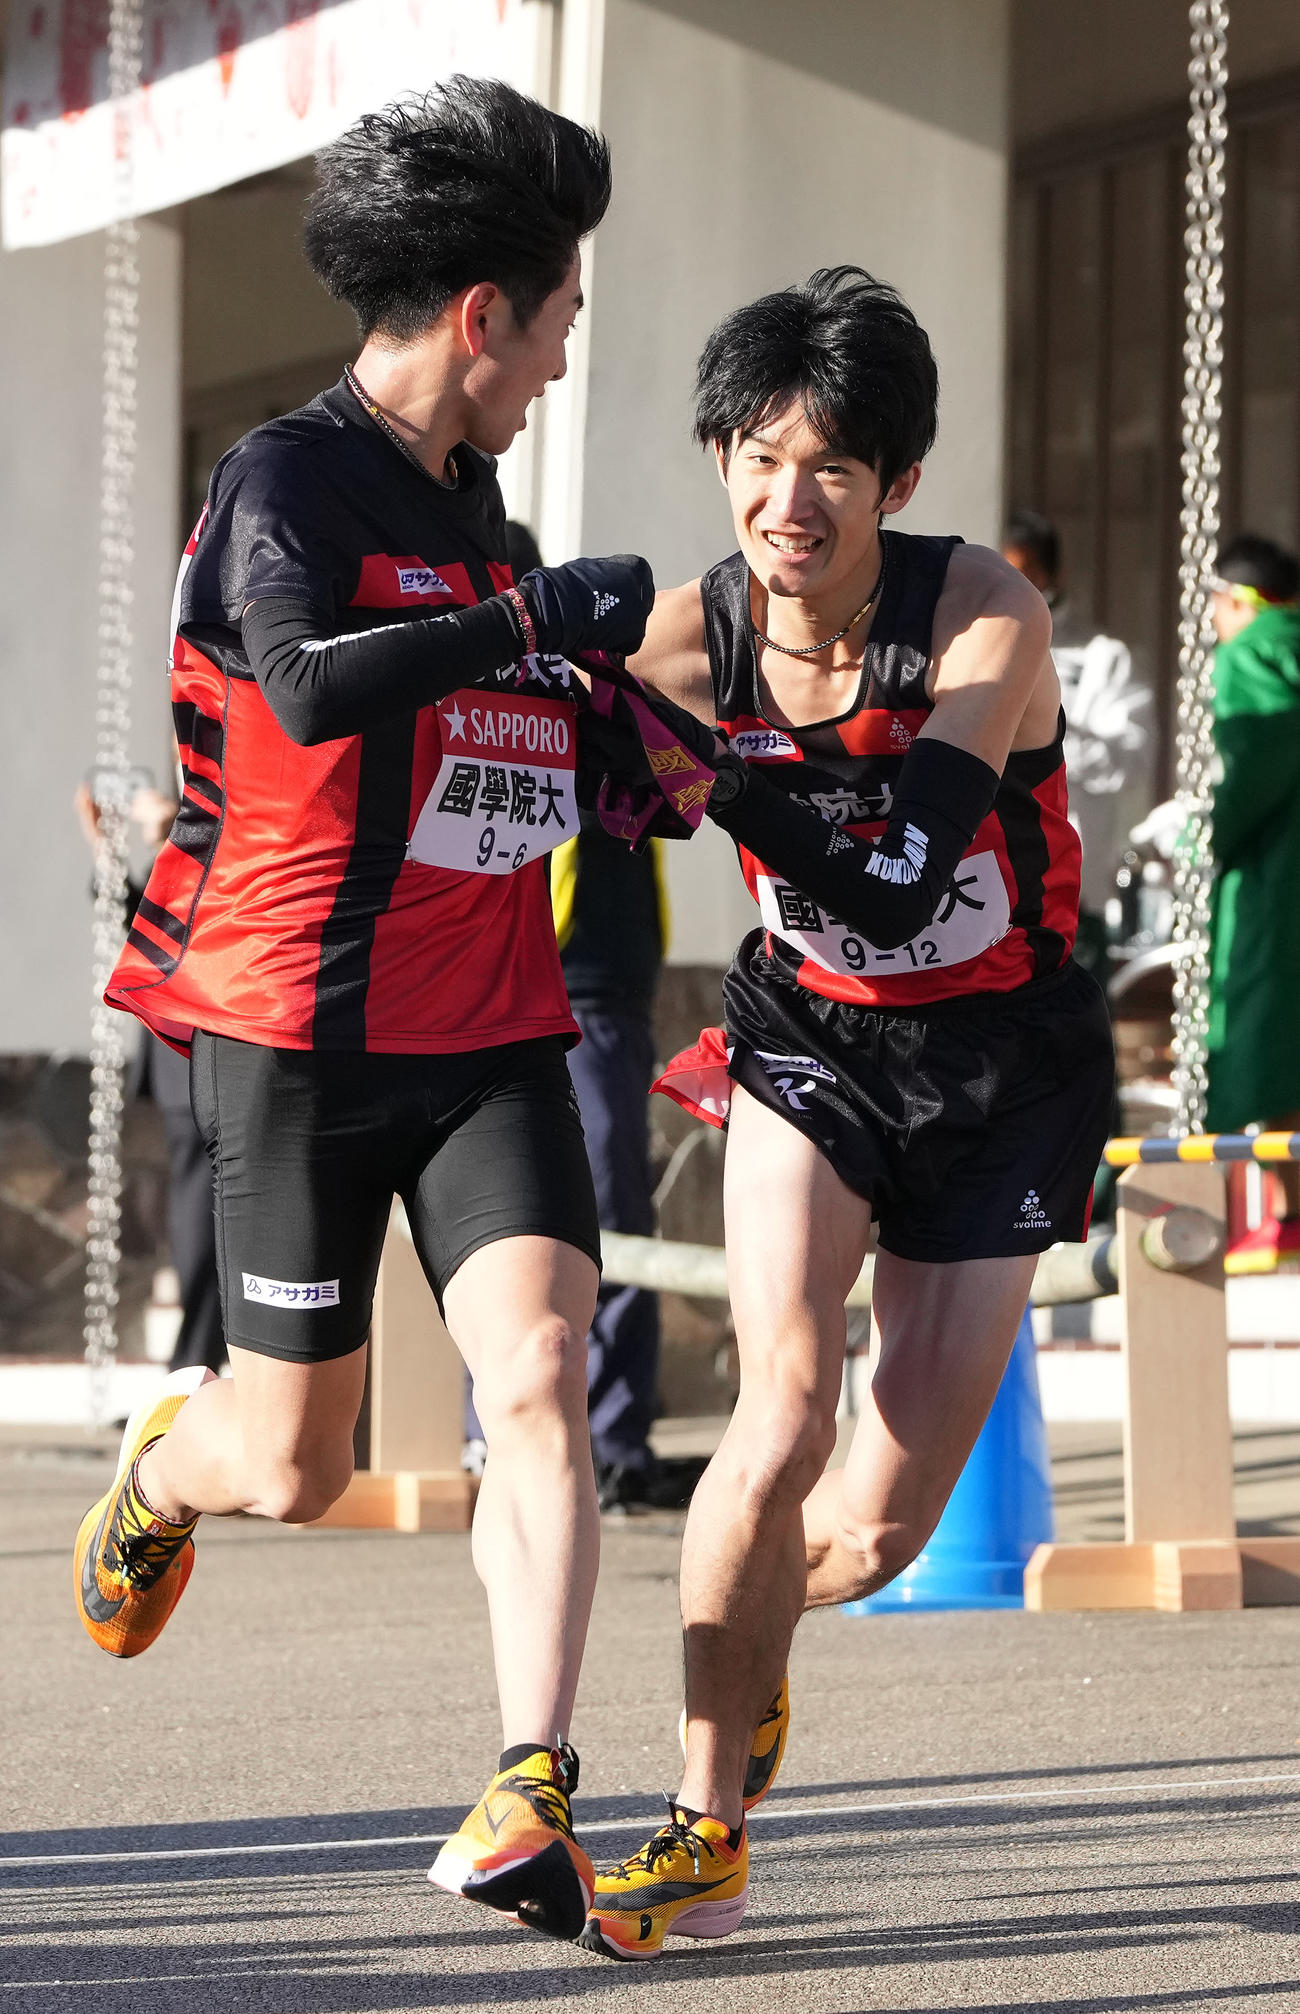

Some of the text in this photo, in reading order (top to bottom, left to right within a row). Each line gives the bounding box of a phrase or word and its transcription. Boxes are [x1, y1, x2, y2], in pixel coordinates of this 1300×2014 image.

[470, 708, 569, 755] SAPPORO
[437, 762, 566, 829] 國學院大
[476, 826, 527, 869] 9-6
[840, 937, 942, 971] 9-12
[1012, 1220, 1052, 1229] svolme
[267, 1284, 335, 1302] アサガミ
